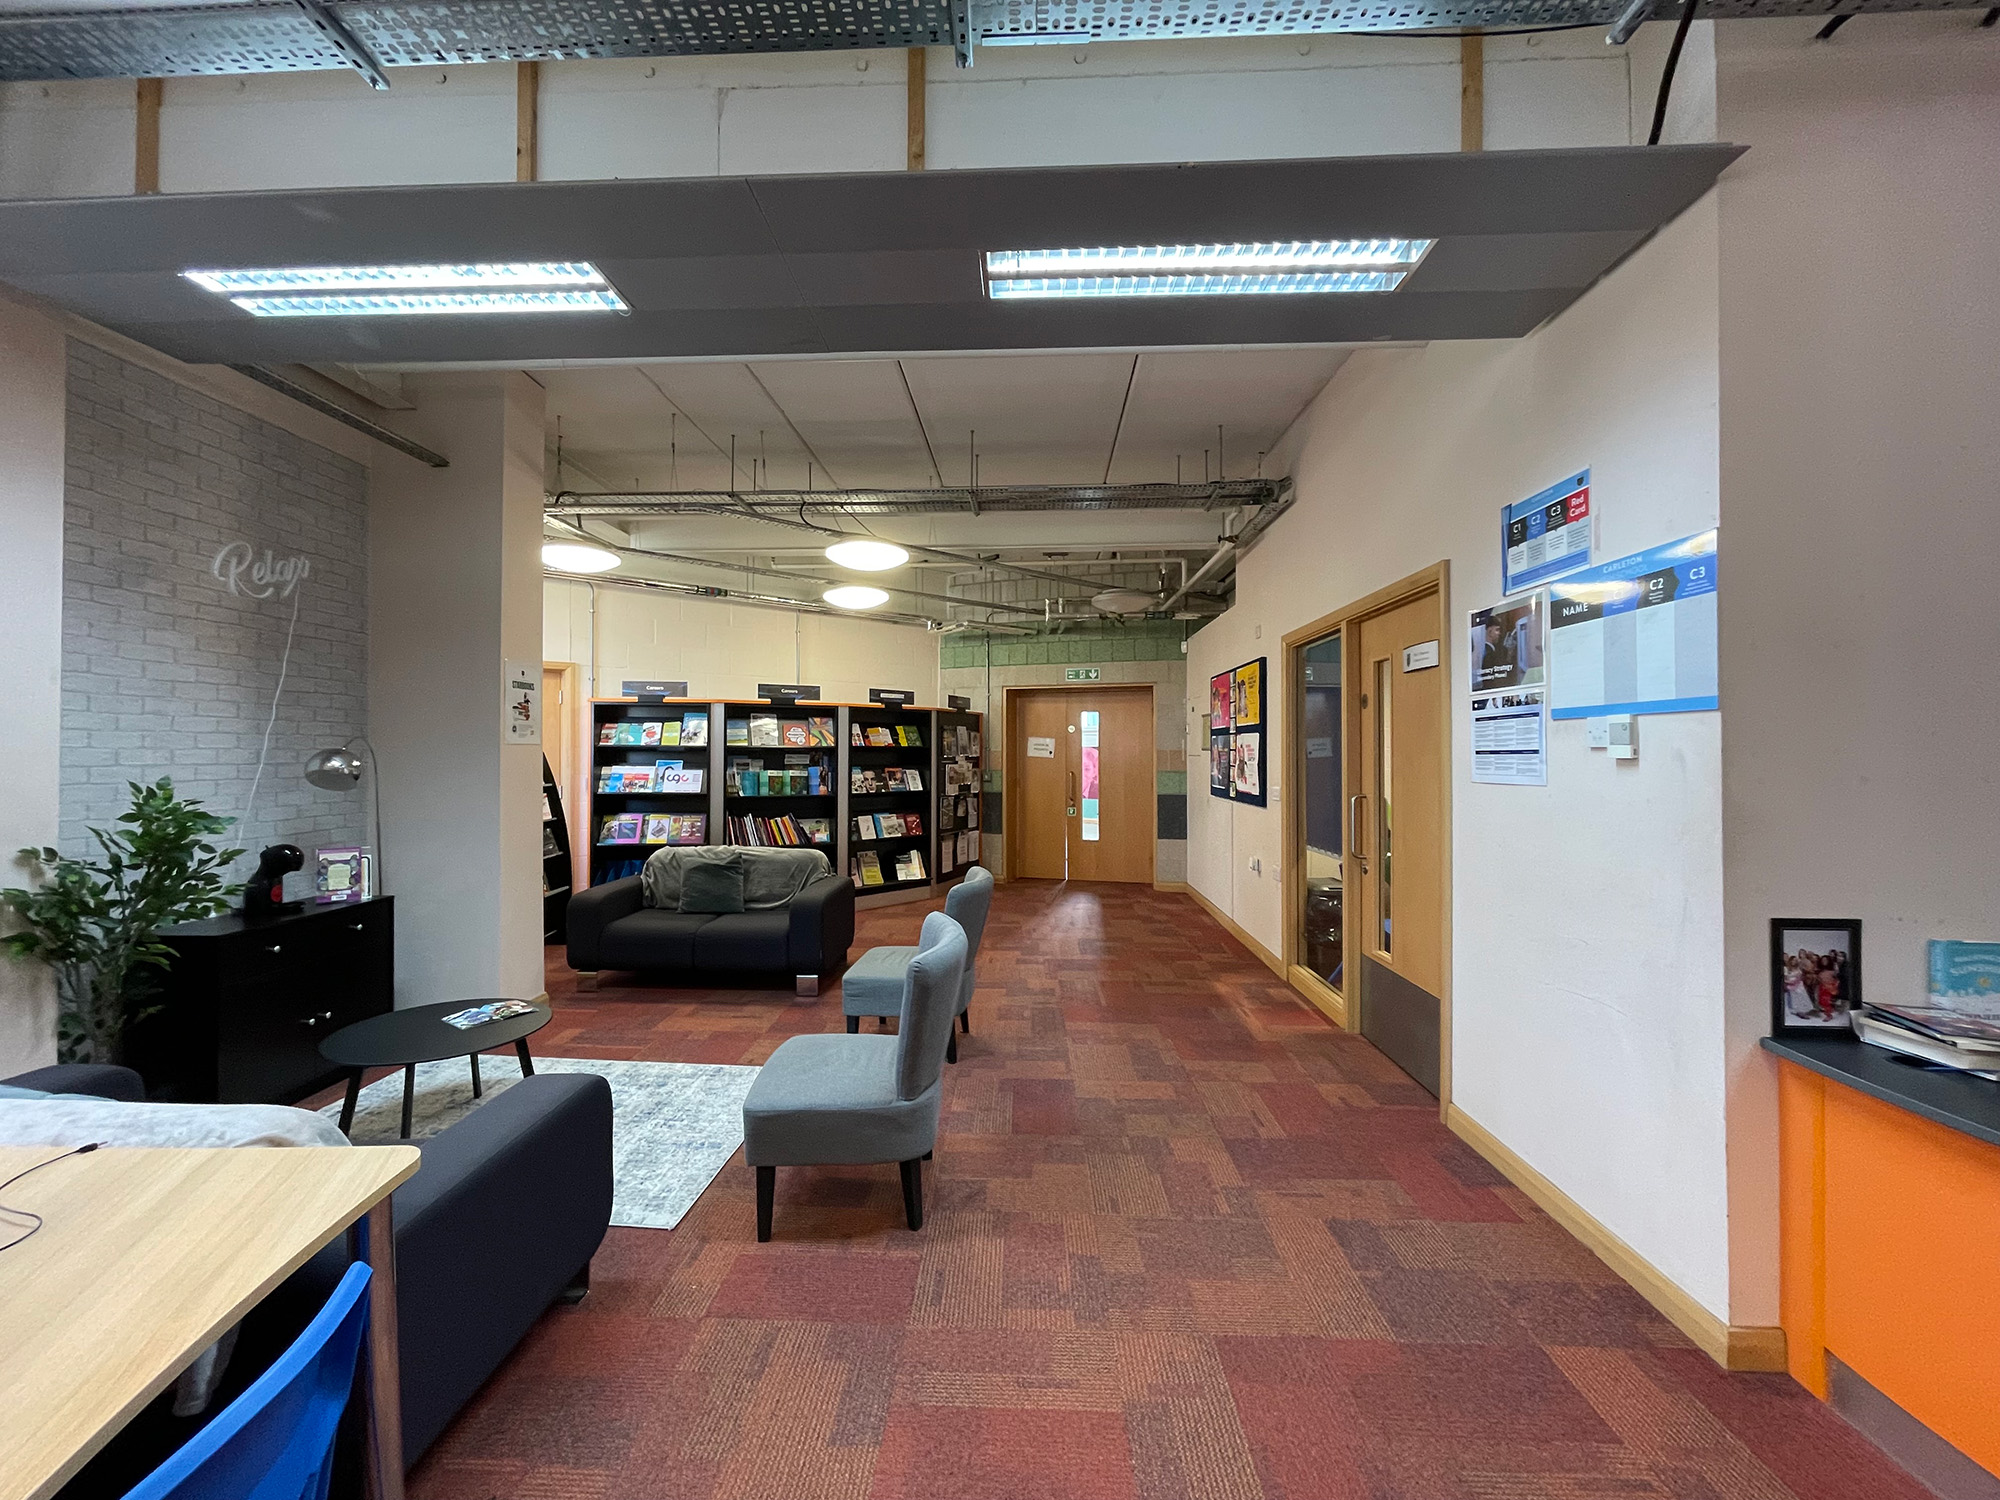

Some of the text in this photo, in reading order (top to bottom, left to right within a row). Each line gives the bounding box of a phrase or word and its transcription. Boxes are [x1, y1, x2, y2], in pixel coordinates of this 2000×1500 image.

[1571, 494, 1584, 507] Red
[1550, 505, 1561, 516] C3
[1569, 504, 1586, 517] Card
[1531, 514, 1541, 525] C2
[1513, 523, 1521, 533] C1
[213, 541, 310, 598] Relax
[1603, 556, 1642, 573] CARLETON
[1689, 566, 1706, 580] C3
[1650, 577, 1664, 591] C2
[1562, 602, 1589, 617] NAME
